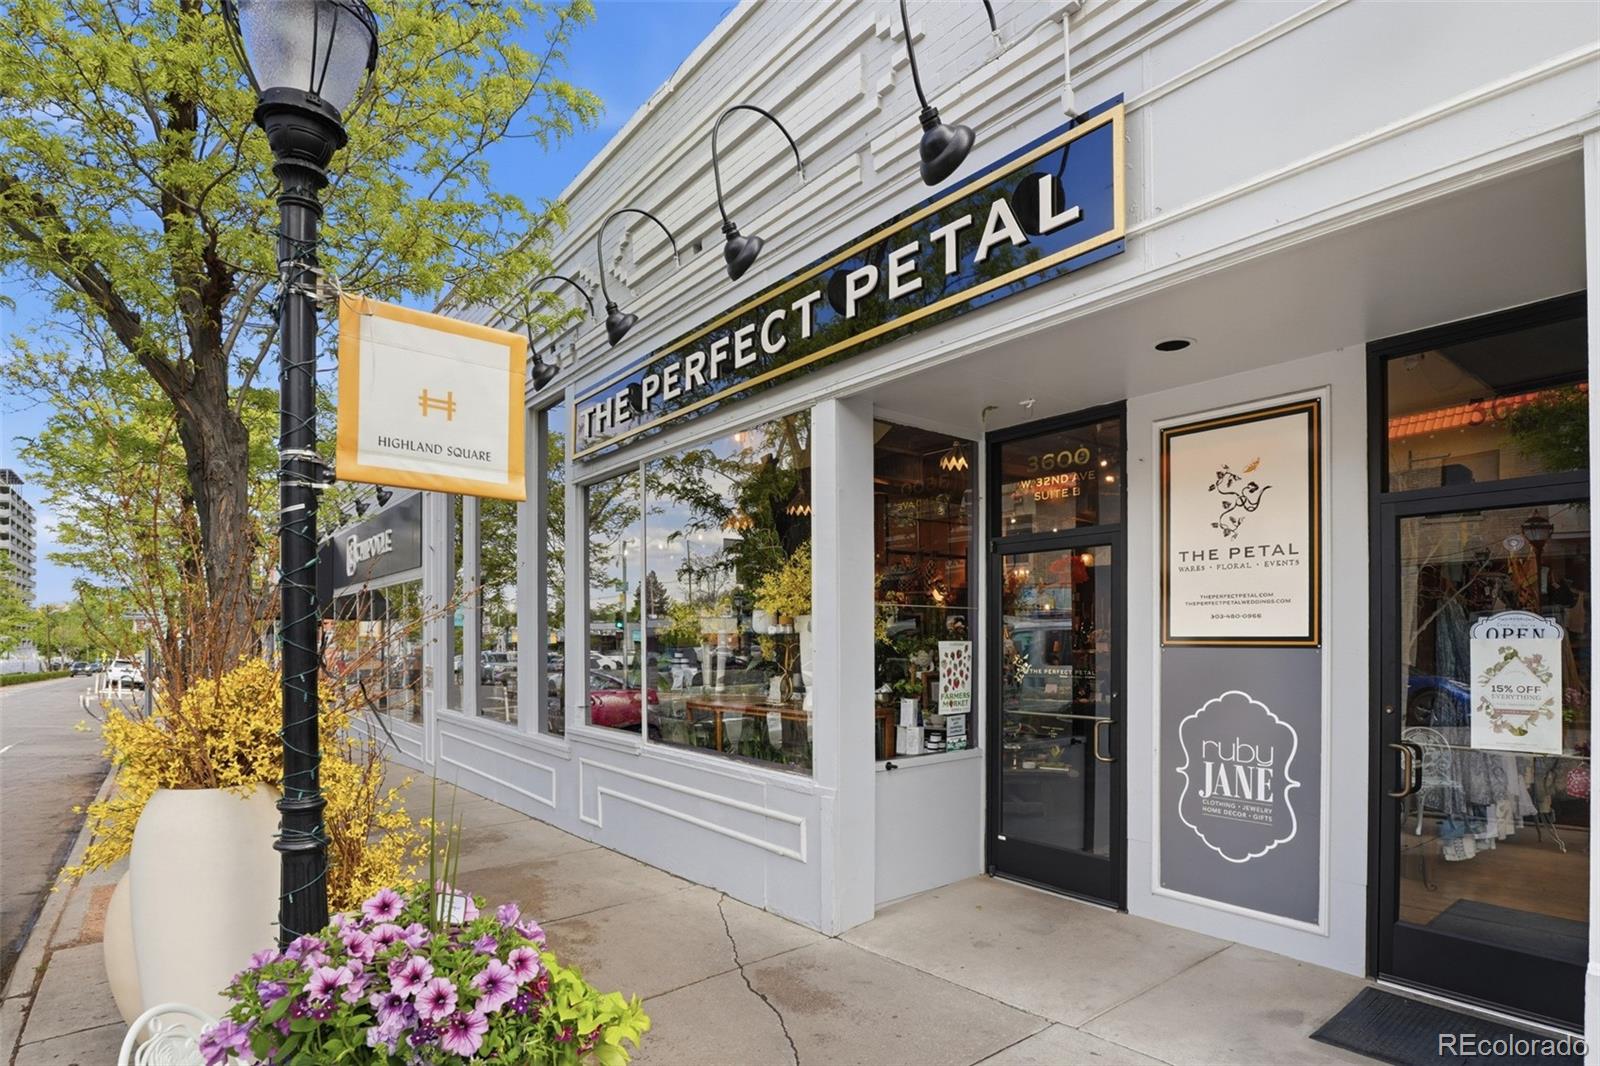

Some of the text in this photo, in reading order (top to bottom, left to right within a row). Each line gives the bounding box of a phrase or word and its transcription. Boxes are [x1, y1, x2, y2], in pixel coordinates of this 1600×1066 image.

[580, 174, 1080, 438] THE PERFECT PETAL
[378, 436, 491, 462] HIGHLAND SQUARE
[1027, 447, 1090, 473] 3600
[1036, 474, 1069, 487] 32ND
[1071, 470, 1096, 482] AVE
[1034, 488, 1069, 501] SUITE
[1178, 543, 1299, 562] THE PETAL
[1177, 559, 1300, 573] WARES FLORAL EVENTS
[940, 692, 970, 700] FARMERS
[1491, 684, 1541, 694] 15% OFF
[1491, 693, 1542, 702] EVERYTHING
[942, 699, 969, 707] MRKET
[1202, 736, 1274, 767] ruby
[1198, 761, 1274, 803] JANE
[1202, 799, 1273, 815] CLOTHING JEWELRY
[1202, 805, 1273, 822] HOME DECOR GIFTS
